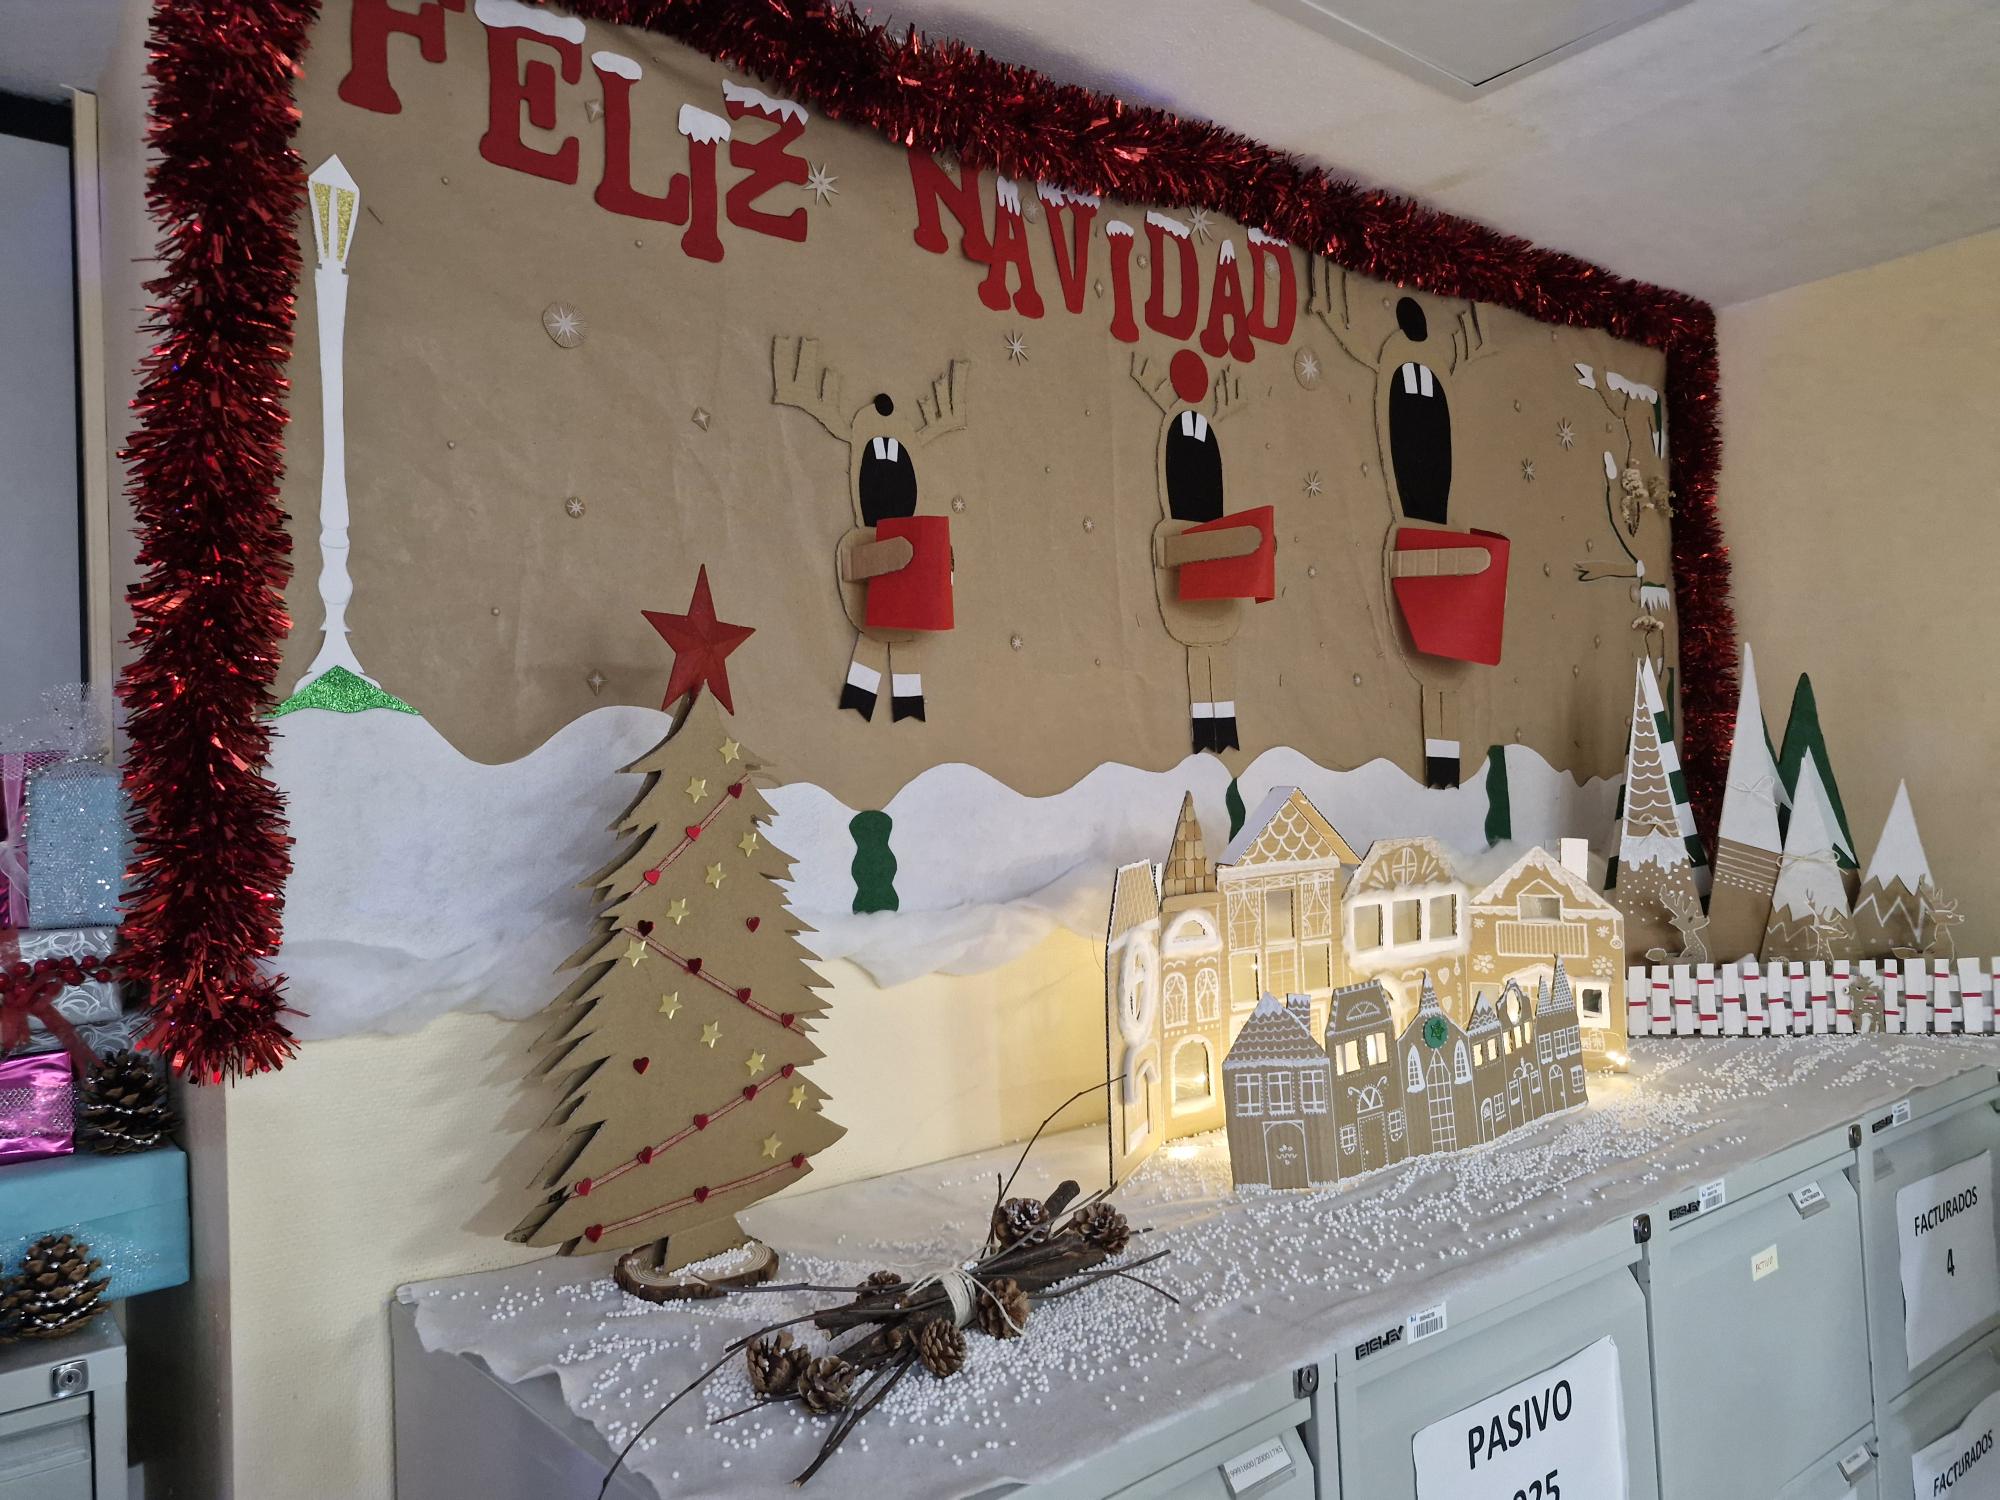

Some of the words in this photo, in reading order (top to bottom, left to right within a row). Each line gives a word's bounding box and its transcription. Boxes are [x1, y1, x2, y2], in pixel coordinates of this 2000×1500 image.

[338, 0, 810, 262] FELIZ
[908, 148, 1298, 363] NAVIDAD
[1913, 1185, 1978, 1237] FACTURADOS
[1946, 1247, 1956, 1277] 4
[1354, 1324, 1404, 1361] BISLEY
[1467, 1379, 1573, 1470] PASIVO
[1932, 1428, 1993, 1498] FACTURADOS
